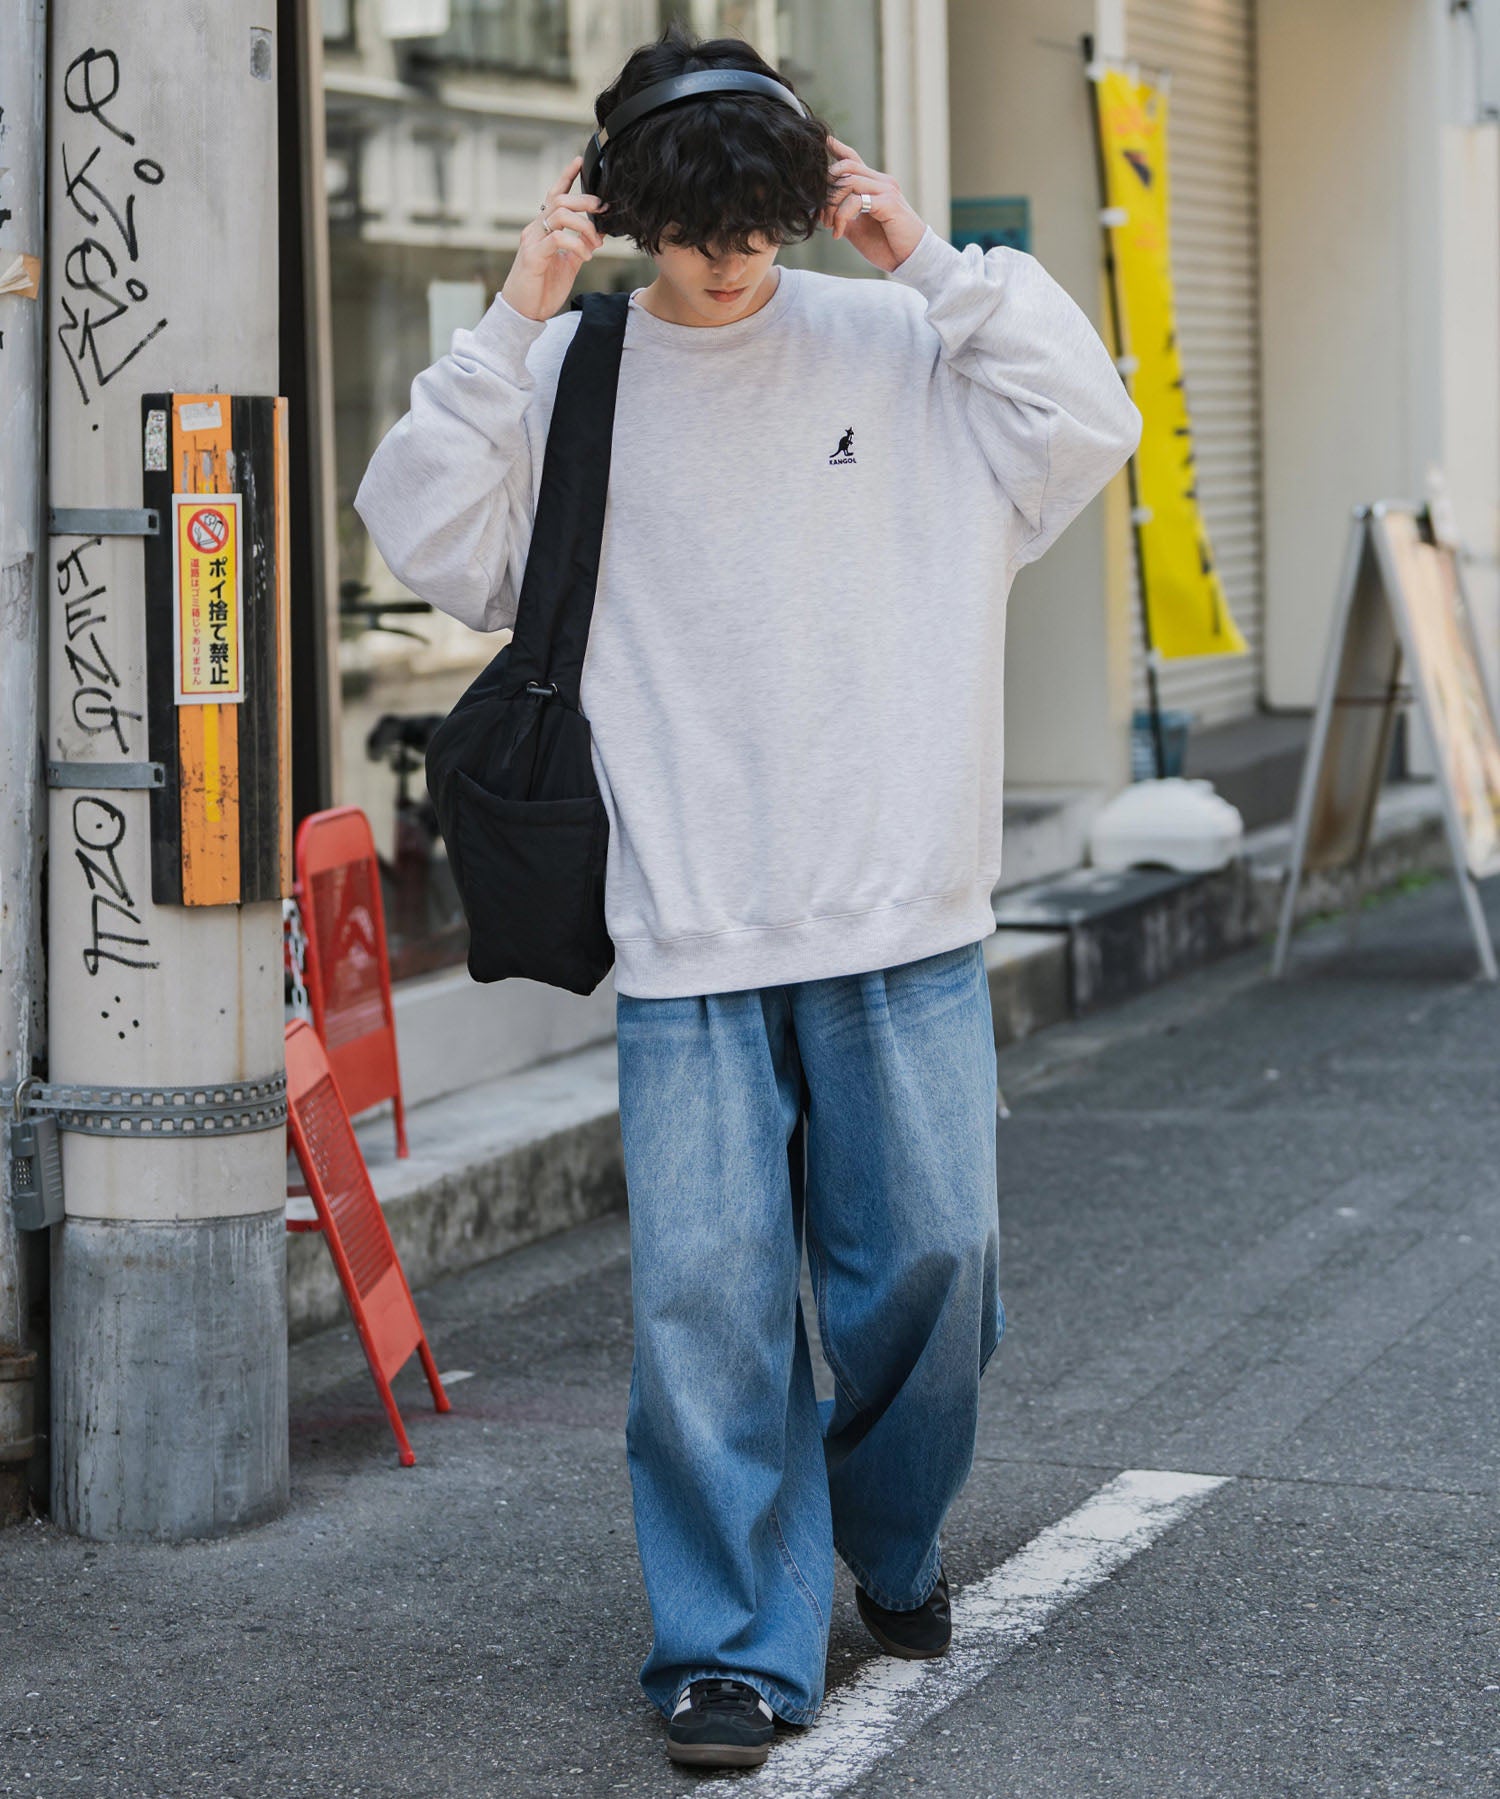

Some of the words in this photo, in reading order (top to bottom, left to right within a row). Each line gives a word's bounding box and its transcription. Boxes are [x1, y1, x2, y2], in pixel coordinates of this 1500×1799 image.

[829, 457, 857, 465] KANGOL
[190, 558, 202, 686] 道路はゴミ箱じゃありません
[208, 556, 229, 684] ポイ捨て禁止
